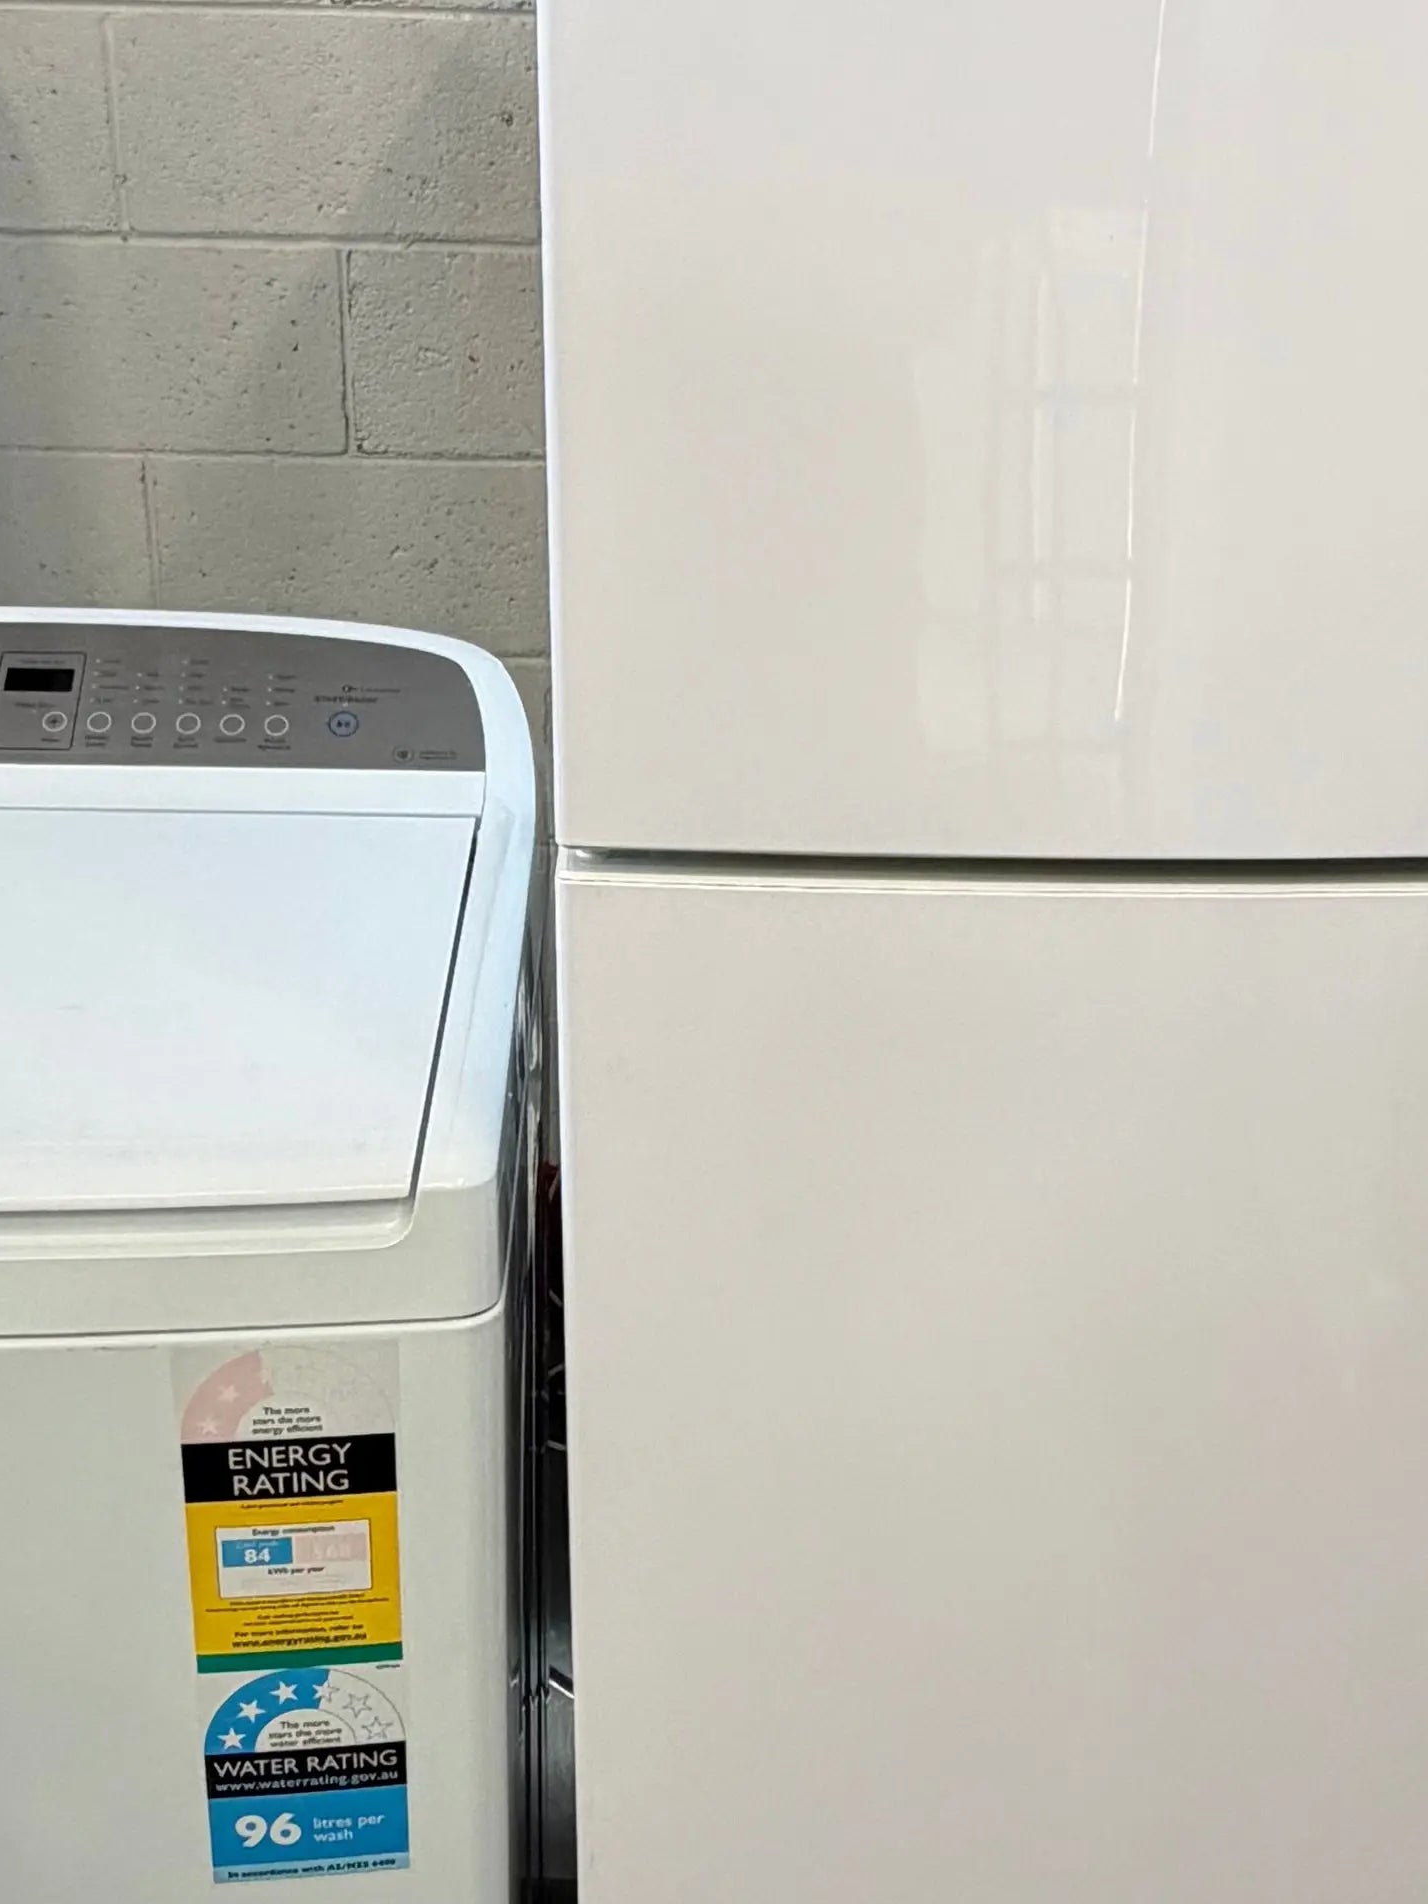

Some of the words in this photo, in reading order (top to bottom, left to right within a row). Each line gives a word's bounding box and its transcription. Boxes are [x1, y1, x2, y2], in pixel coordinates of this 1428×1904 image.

[228, 1442, 352, 1470] ENERGY
[233, 1469, 350, 1497] RATING
[243, 1547, 272, 1564] 84
[268, 1730, 293, 1740] stars
[295, 1728, 313, 1738] the
[315, 1727, 343, 1737] more
[280, 1720, 300, 1730] The
[302, 1719, 331, 1729] more
[213, 1756, 300, 1779] WATER
[306, 1749, 399, 1773] RATING
[215, 1769, 399, 1792] www.waterrating.gov.au
[234, 1811, 303, 1848] 96
[313, 1816, 353, 1830] litres
[357, 1813, 386, 1830] per
[313, 1829, 354, 1843] wash
